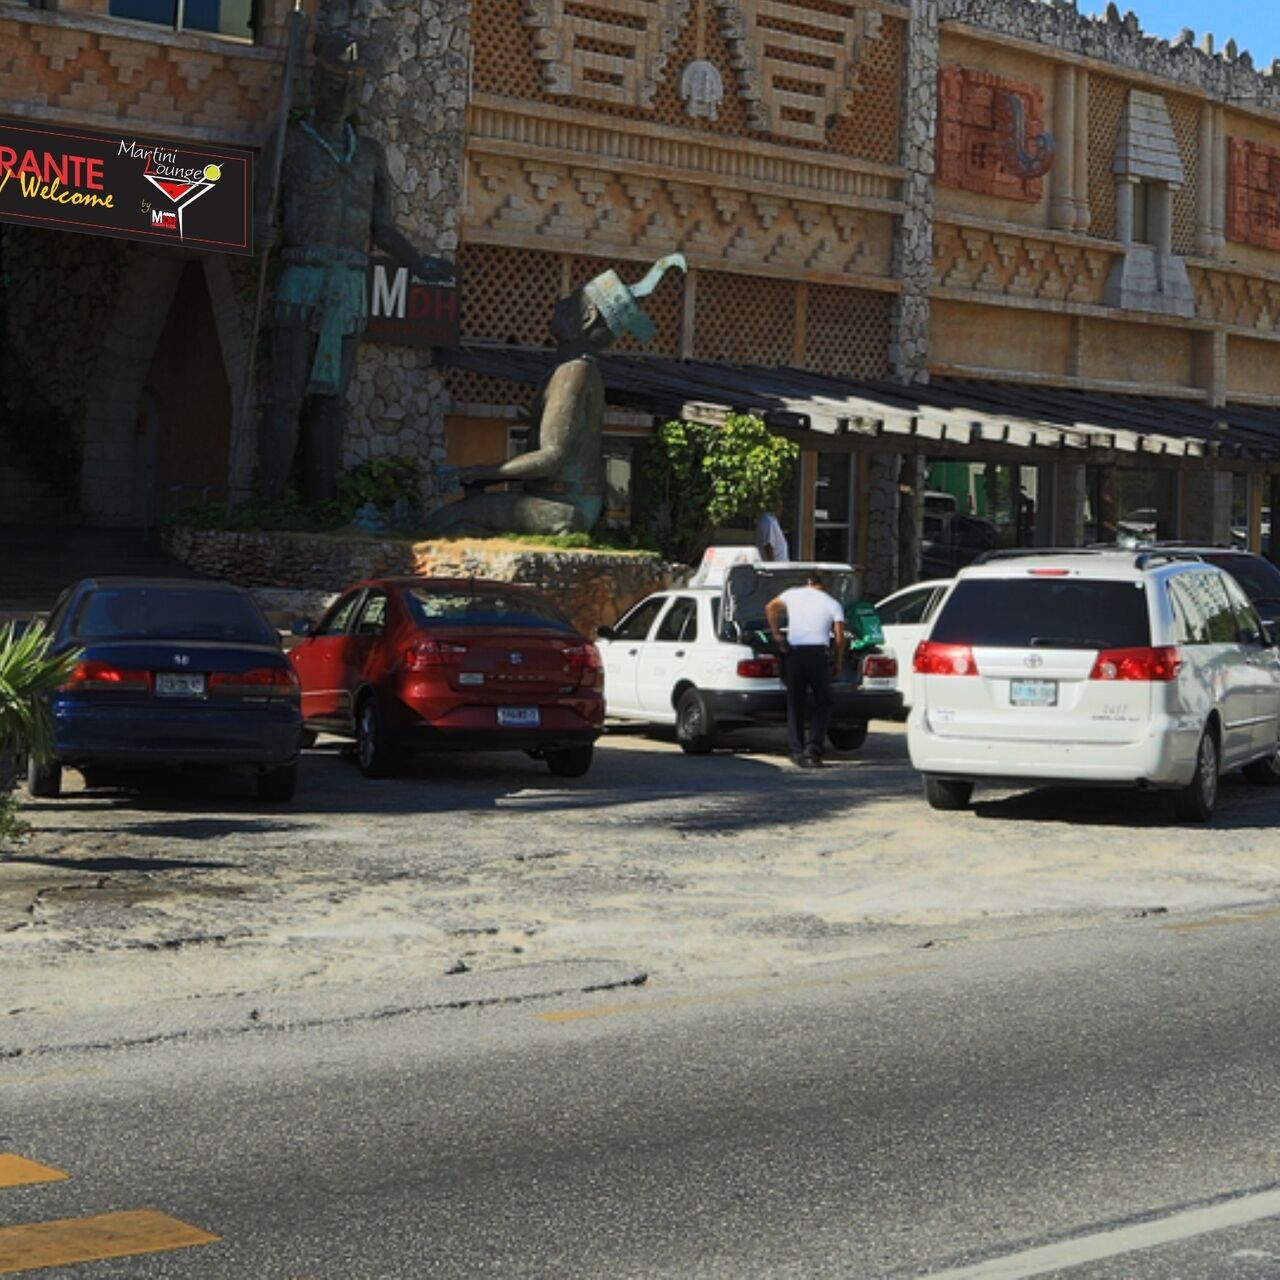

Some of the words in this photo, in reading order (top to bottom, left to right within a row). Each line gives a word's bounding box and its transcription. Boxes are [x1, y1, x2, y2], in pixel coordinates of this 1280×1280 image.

[117, 139, 178, 166] Martini
[144, 154, 202, 186] Lounge
[18, 170, 115, 209] Welcome
[141, 199, 152, 213] by
[371, 264, 458, 320] MDH
